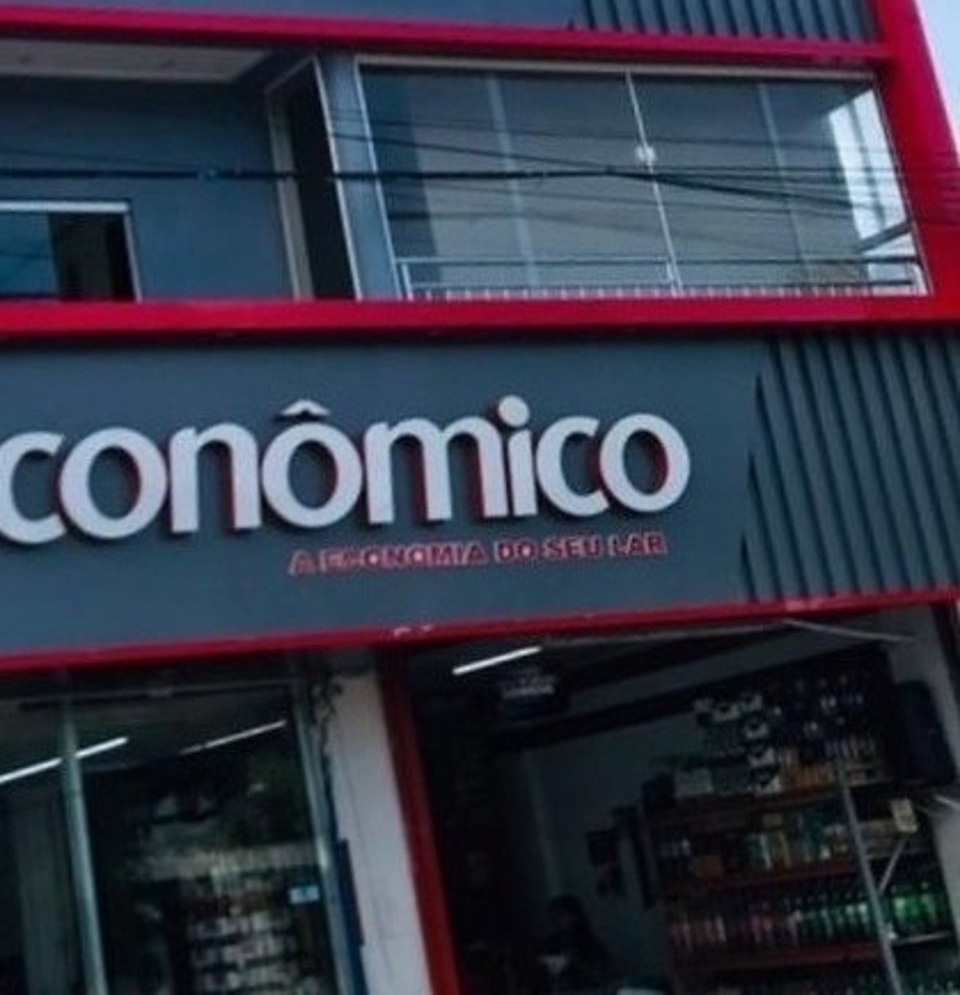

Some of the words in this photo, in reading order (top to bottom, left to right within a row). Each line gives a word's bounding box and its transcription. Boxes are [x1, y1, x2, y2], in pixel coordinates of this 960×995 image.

[288, 549, 316, 577] A
[493, 538, 539, 563] DO
[542, 534, 604, 560] SEU
[608, 531, 668, 558] LAR
